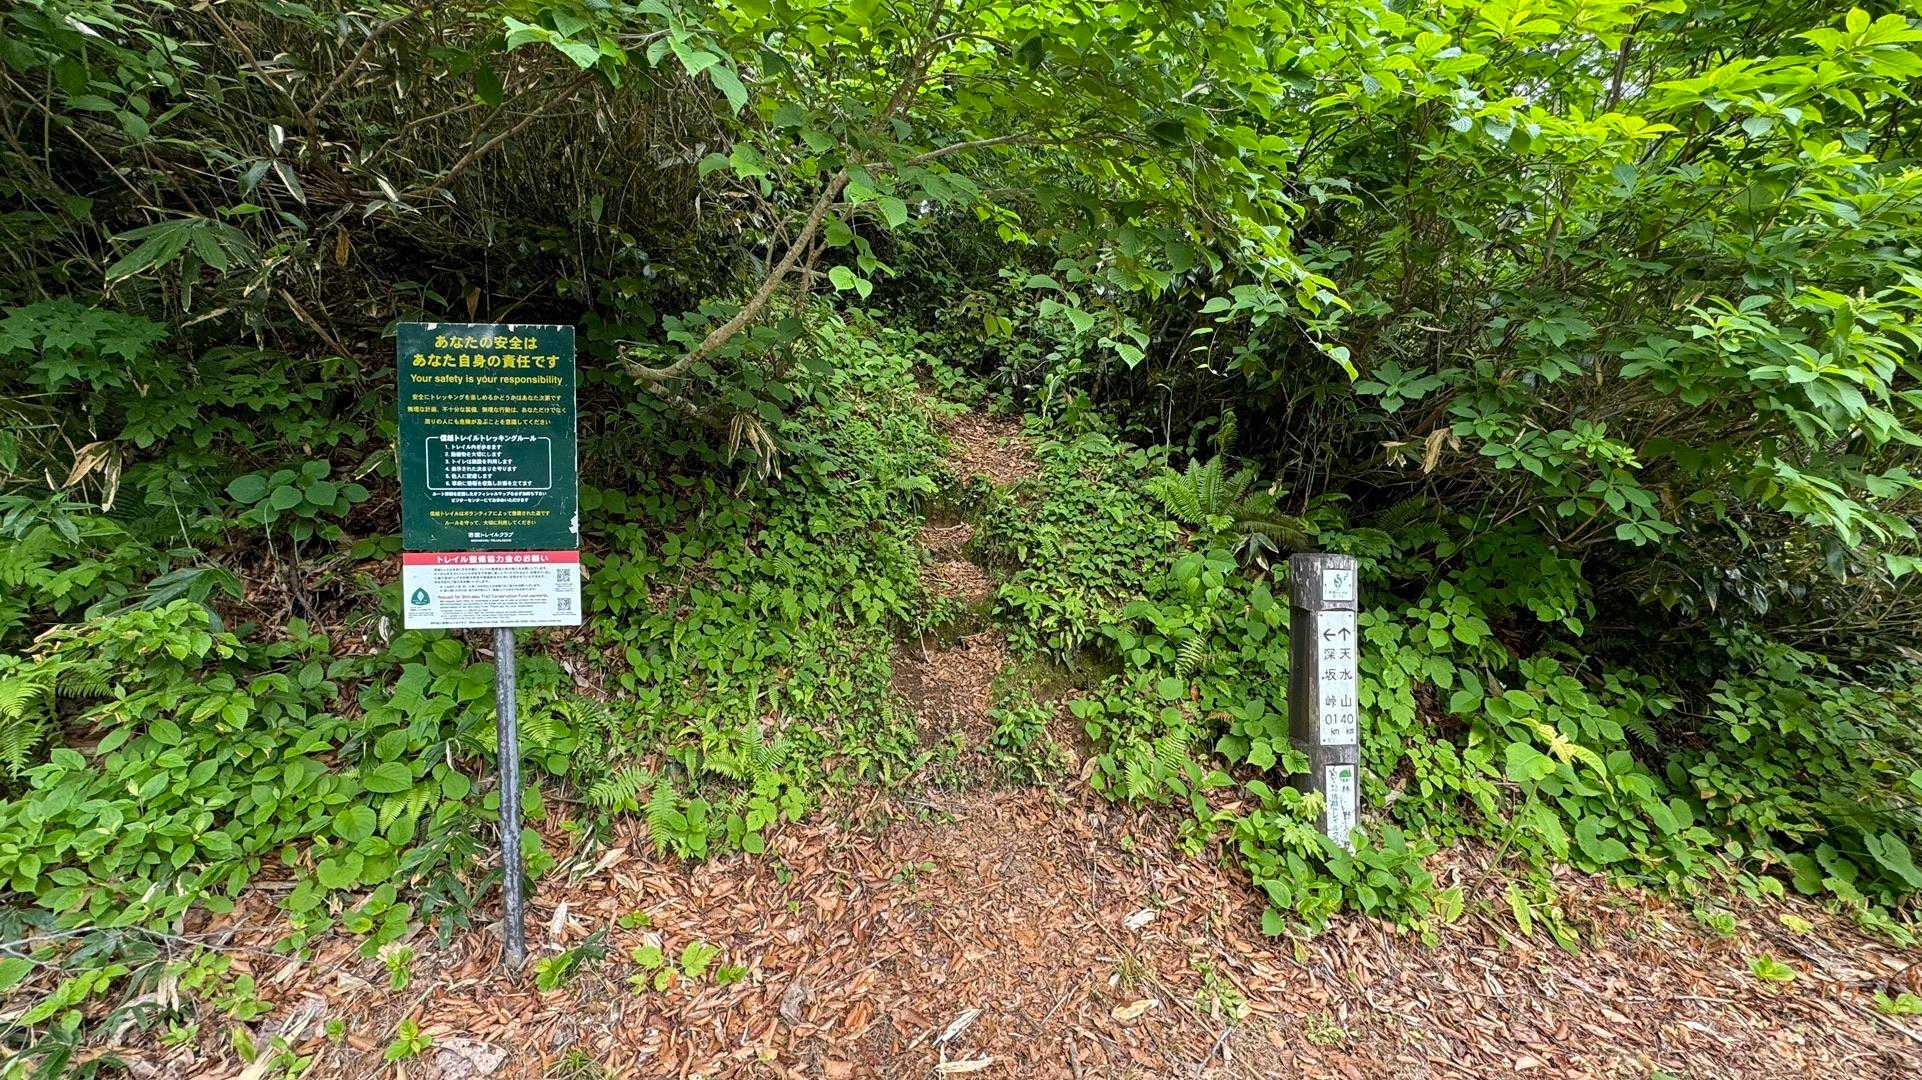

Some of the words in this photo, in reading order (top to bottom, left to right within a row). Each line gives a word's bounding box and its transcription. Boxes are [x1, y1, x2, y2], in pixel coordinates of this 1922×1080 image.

[434, 335, 538, 350] あなたの安全は
[412, 354, 560, 368] あなた自身の責任です
[410, 374, 432, 382] Your
[435, 374, 463, 385] safety
[465, 374, 474, 383] is
[476, 376, 497, 386] your
[500, 375, 563, 386] responsibility
[1324, 648, 1336, 708] 深坂峠
[1339, 648, 1352, 707] 天水山
